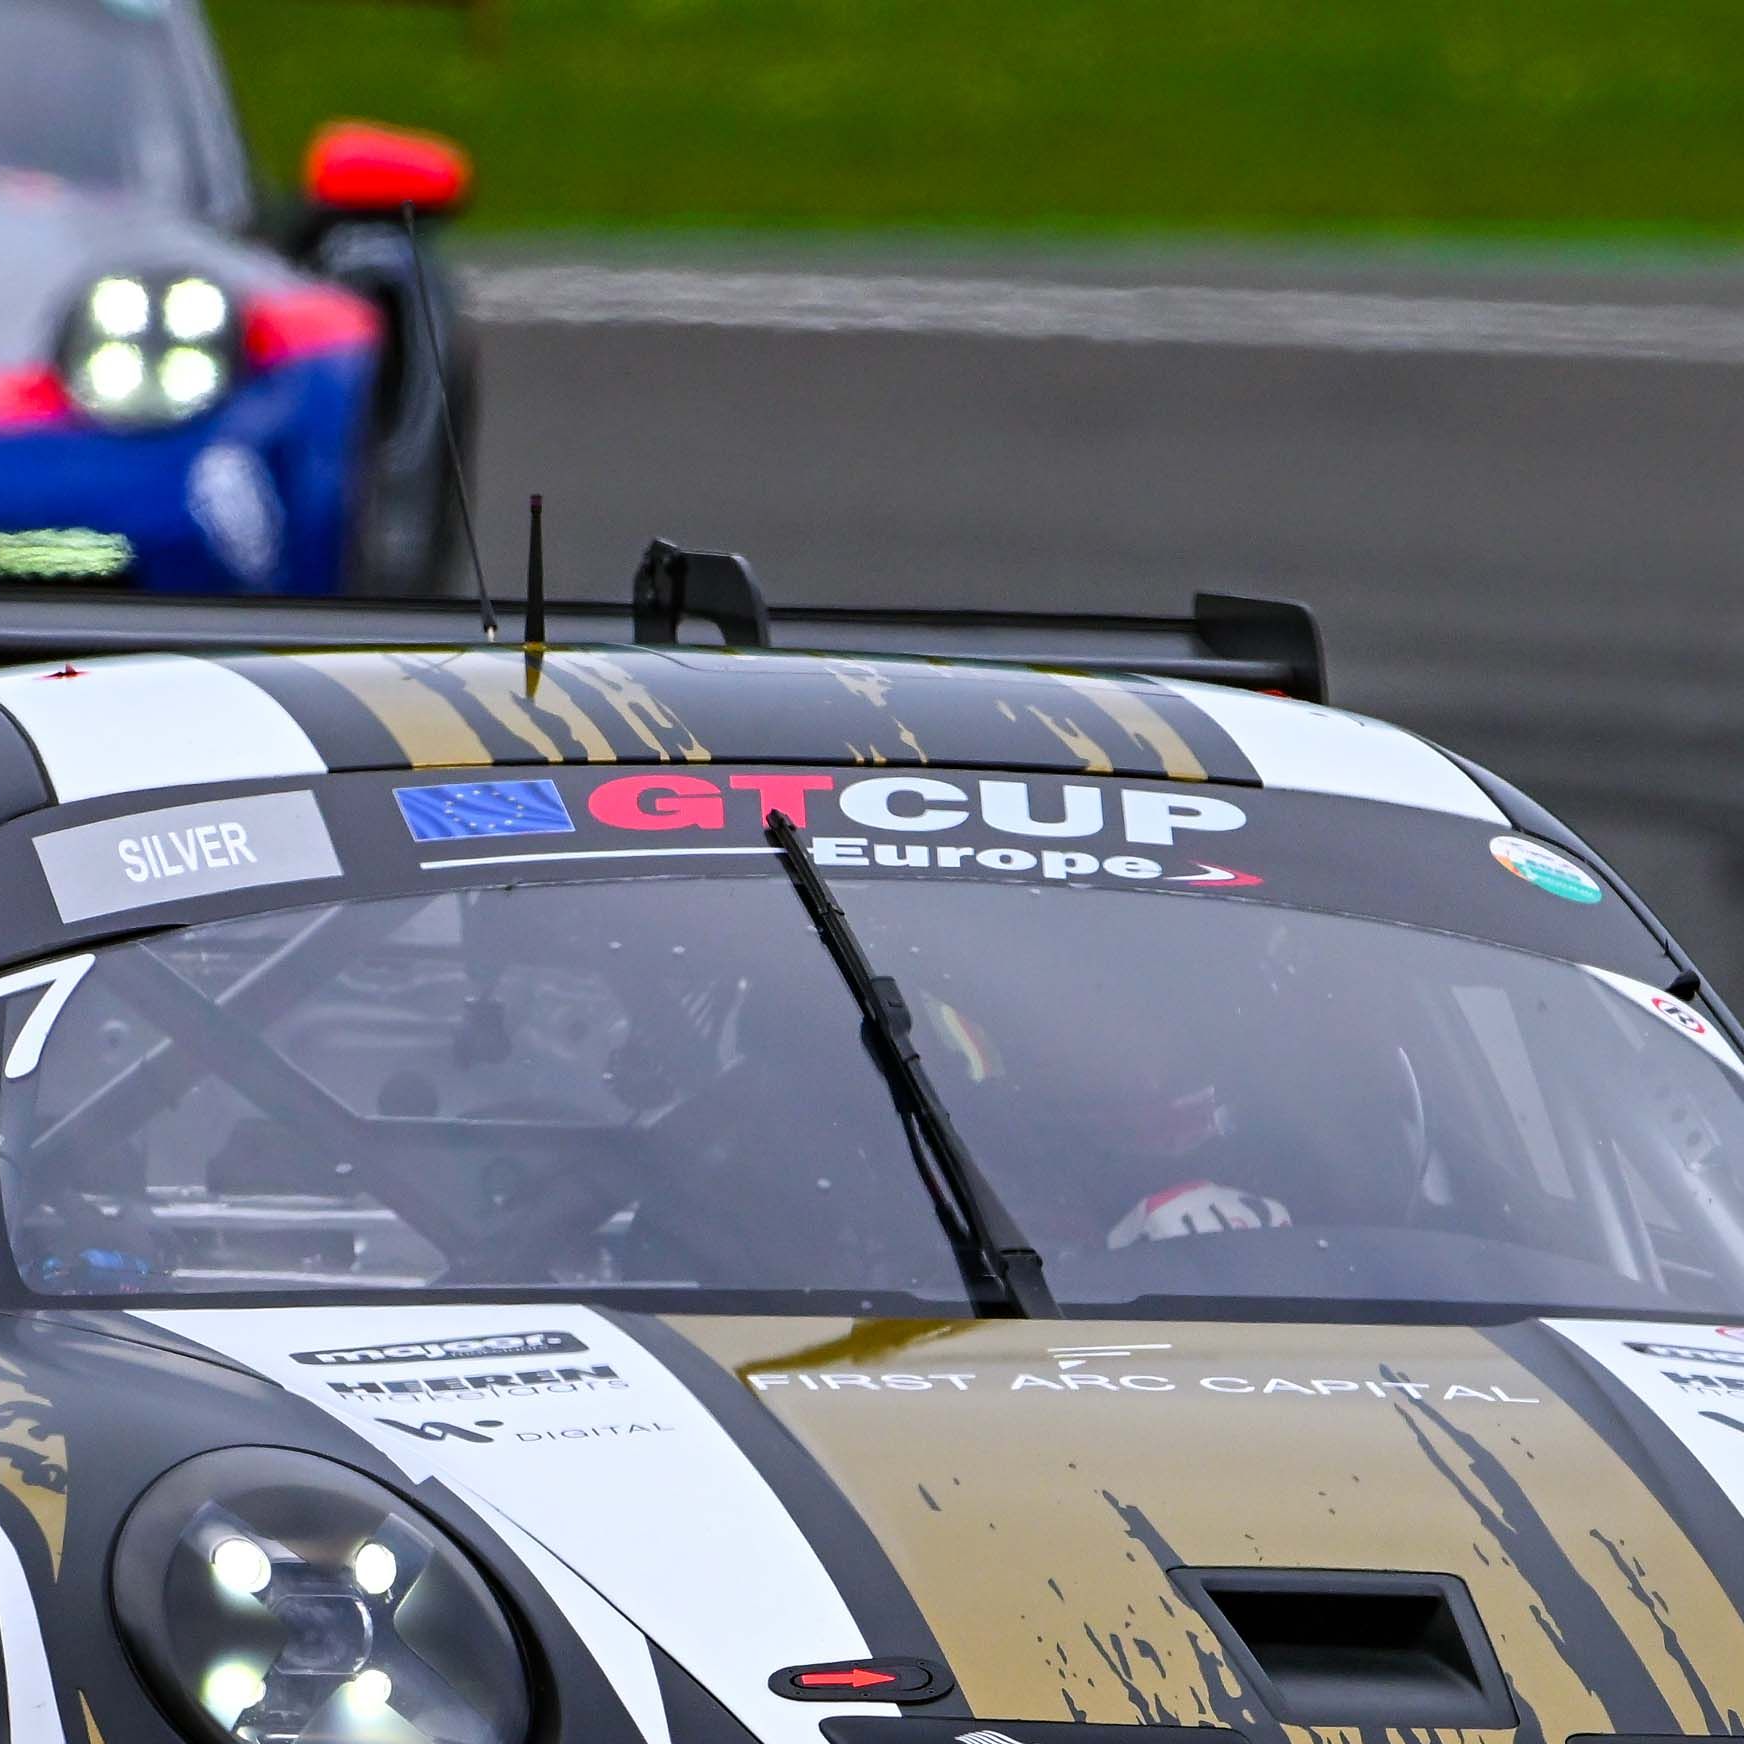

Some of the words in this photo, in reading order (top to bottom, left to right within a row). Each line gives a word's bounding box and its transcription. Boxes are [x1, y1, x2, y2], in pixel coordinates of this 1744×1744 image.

[117, 821, 258, 882] SILVER
[814, 837, 1165, 882] Europe
[326, 1365, 619, 1393] HEEREN
[749, 1372, 976, 1391] FIRST
[1010, 1373, 1176, 1393] ARC
[1199, 1375, 1541, 1404] CAPITAL
[515, 1422, 676, 1443] DIGITAL
